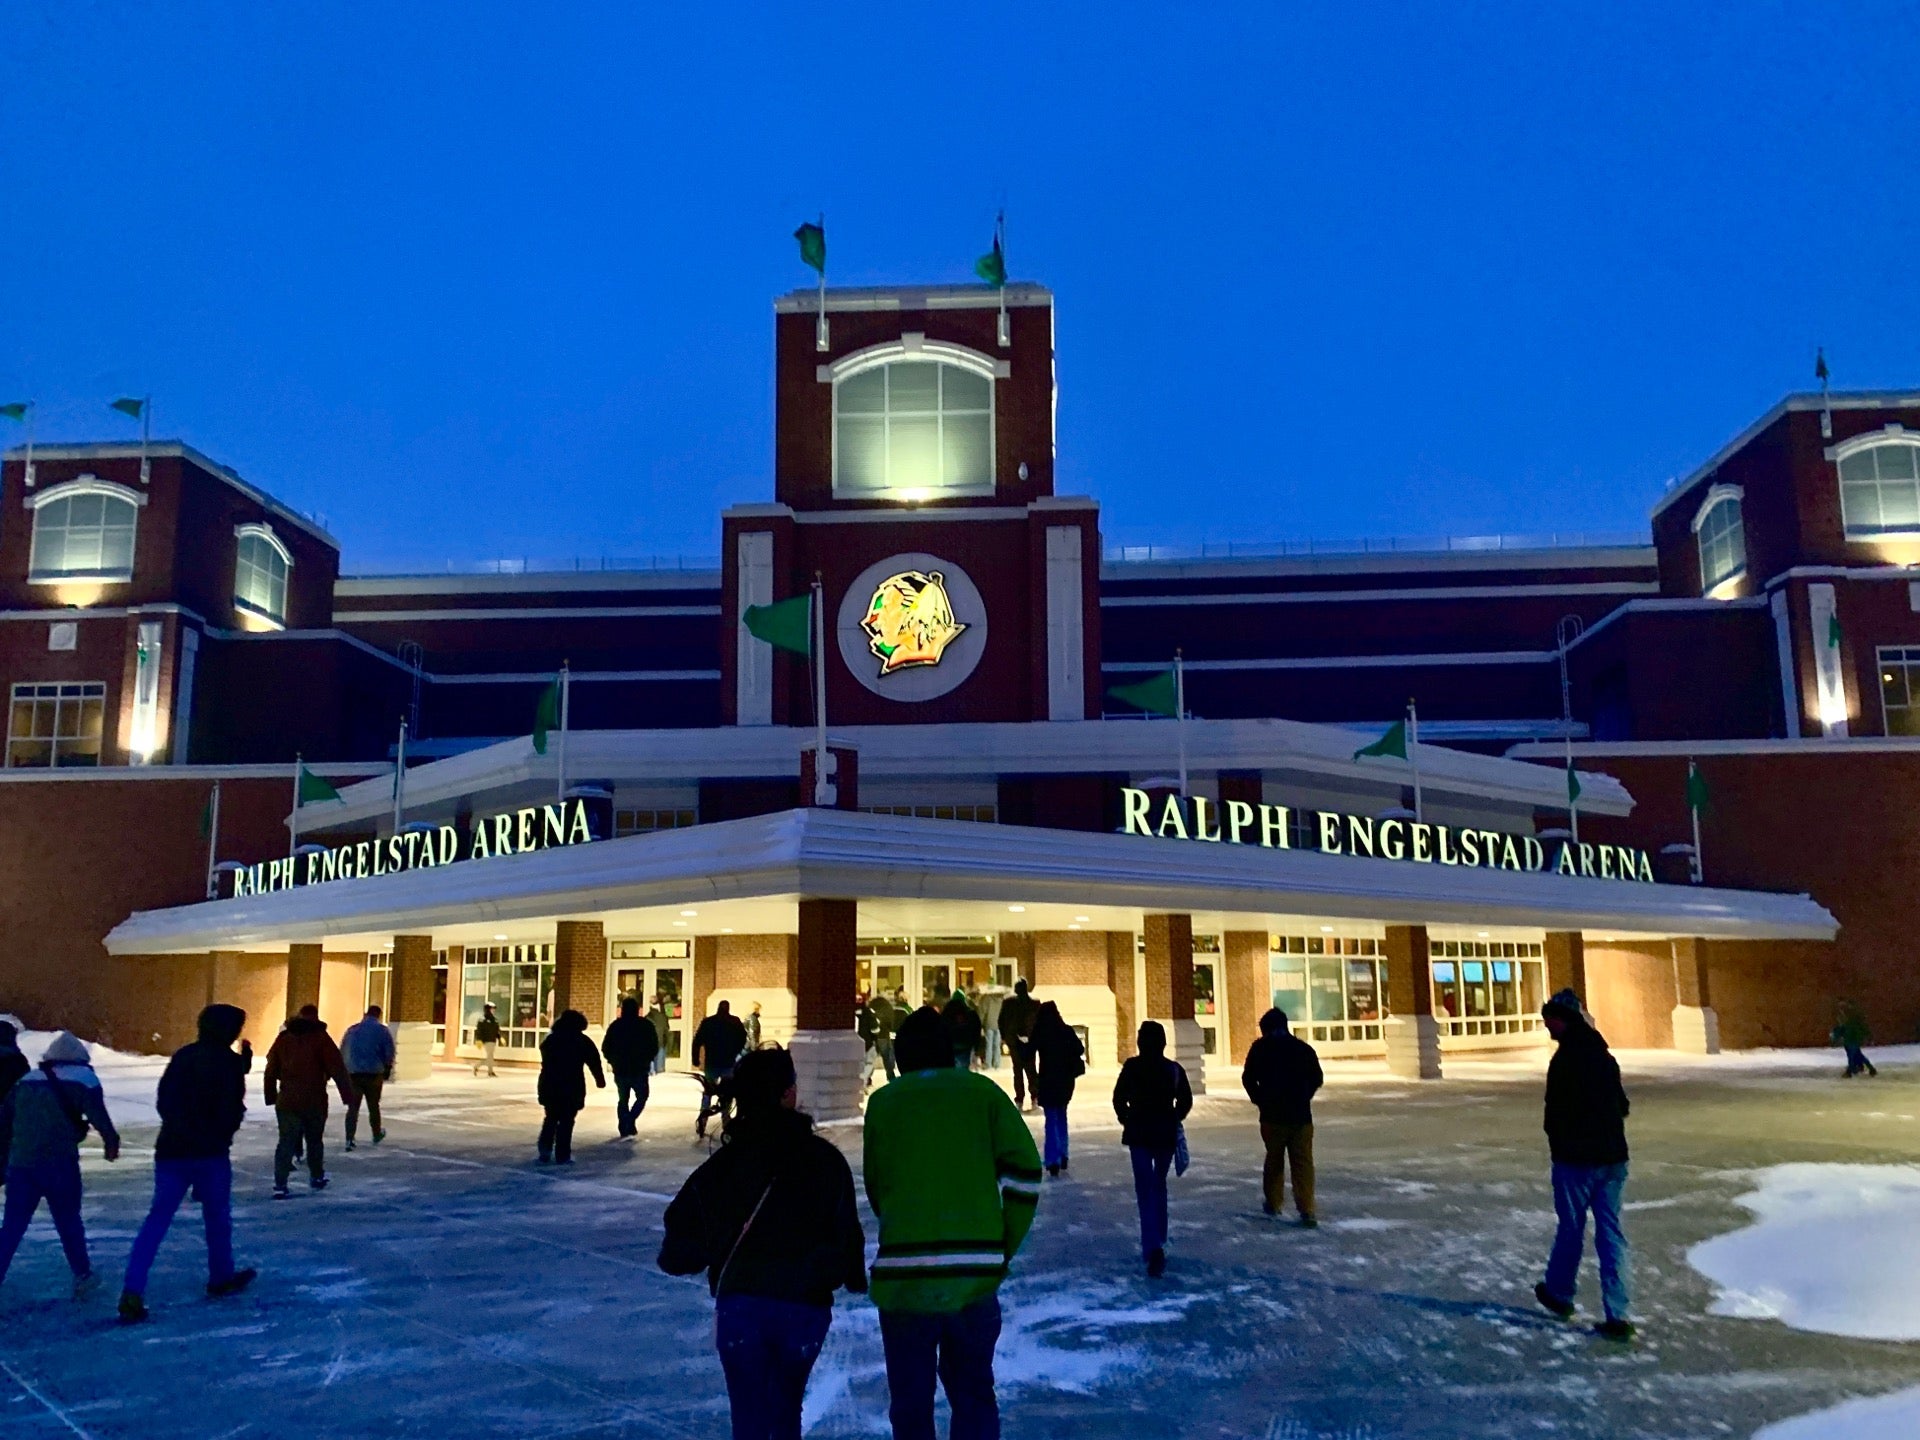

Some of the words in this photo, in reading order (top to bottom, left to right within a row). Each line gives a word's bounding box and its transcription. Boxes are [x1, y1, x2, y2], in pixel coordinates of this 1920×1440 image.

[233, 855, 295, 899] RALPH
[306, 825, 458, 886] ENGELSTAD
[471, 799, 592, 860] ARENA
[1120, 787, 1291, 850] RALPH
[1317, 810, 1546, 872] ENGELSTAD
[1557, 841, 1655, 883] ARENA
